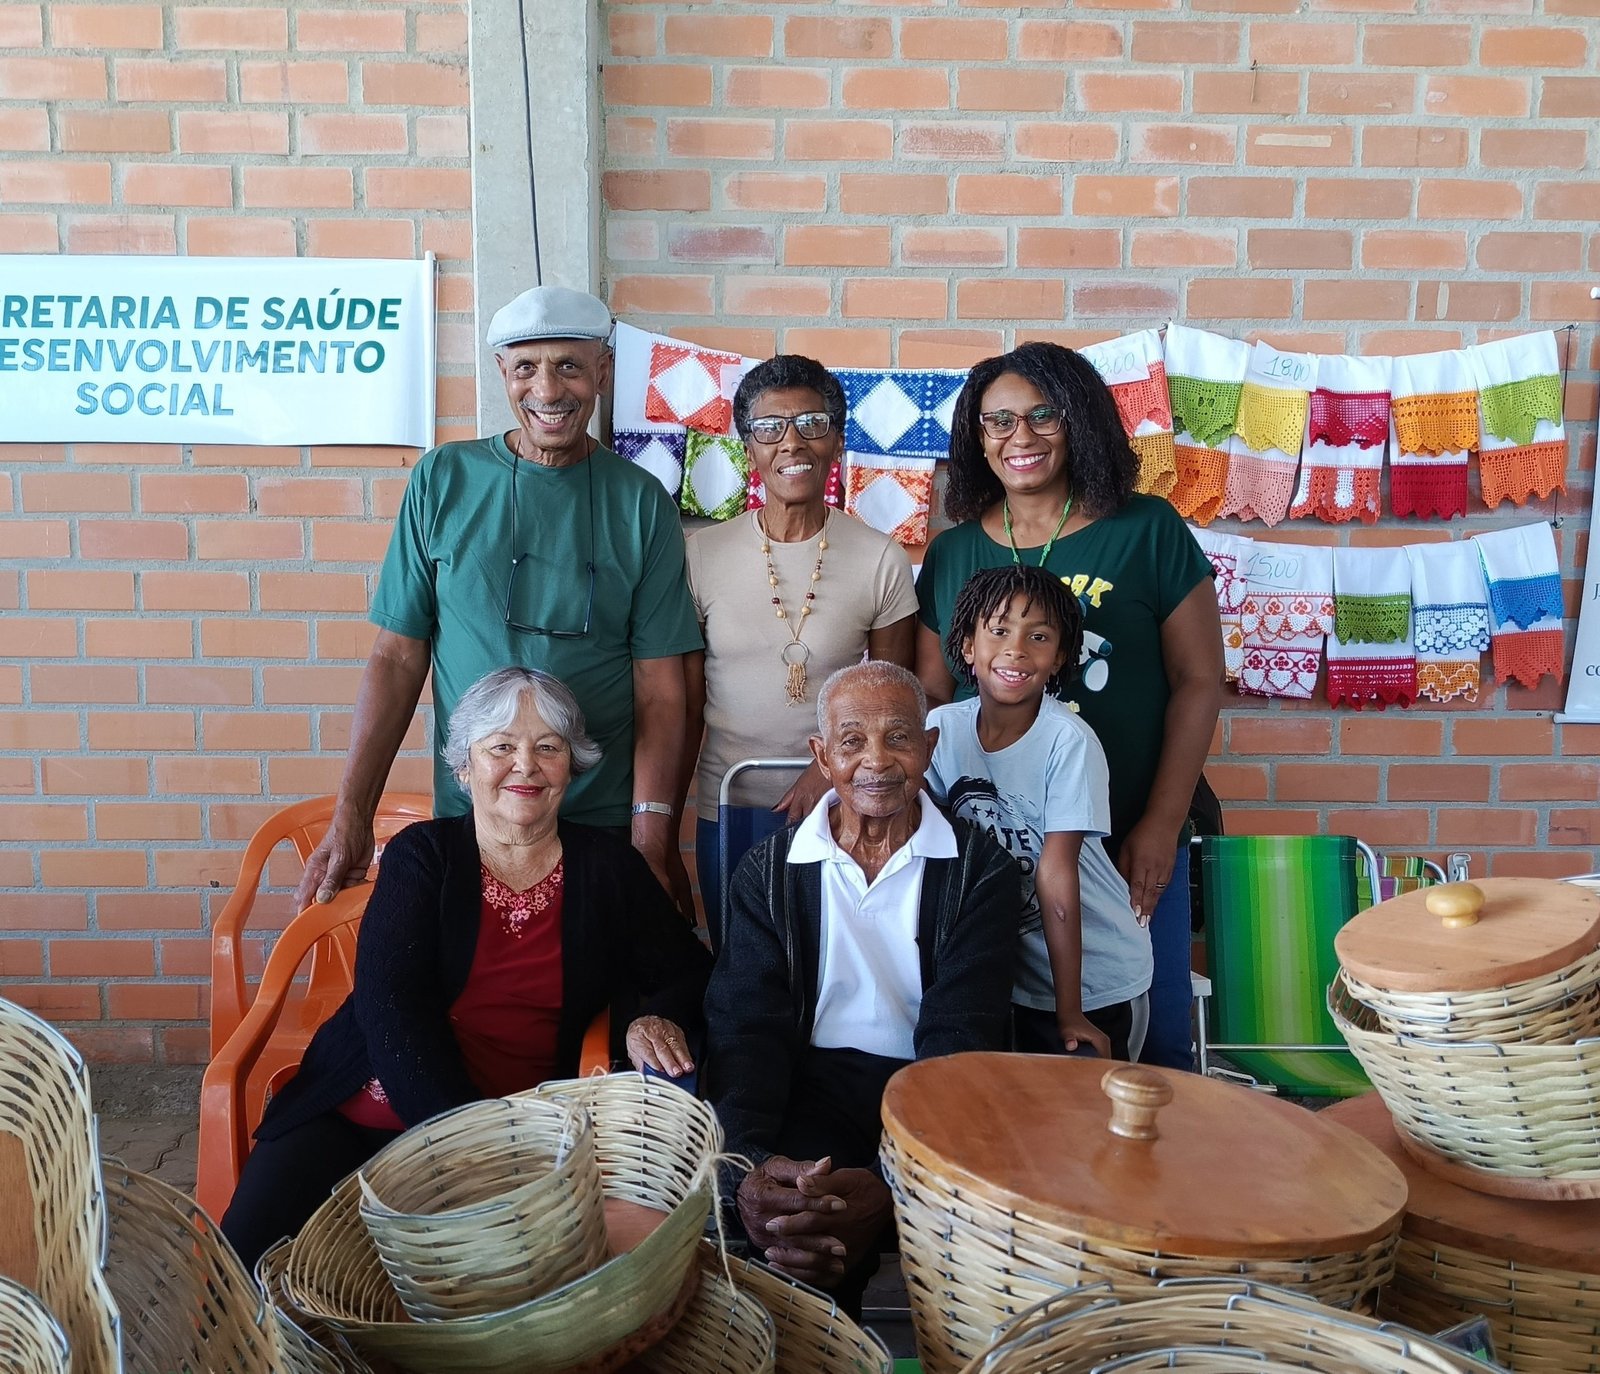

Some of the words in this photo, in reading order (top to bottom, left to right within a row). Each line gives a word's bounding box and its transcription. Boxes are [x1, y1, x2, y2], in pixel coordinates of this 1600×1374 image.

[2, 294, 181, 329] RETARIA
[193, 296, 250, 330] DE
[261, 287, 402, 331] SAÚDE
[0, 338, 386, 374] ESENVOLVIMENTO
[75, 381, 235, 416] SOCIAL
